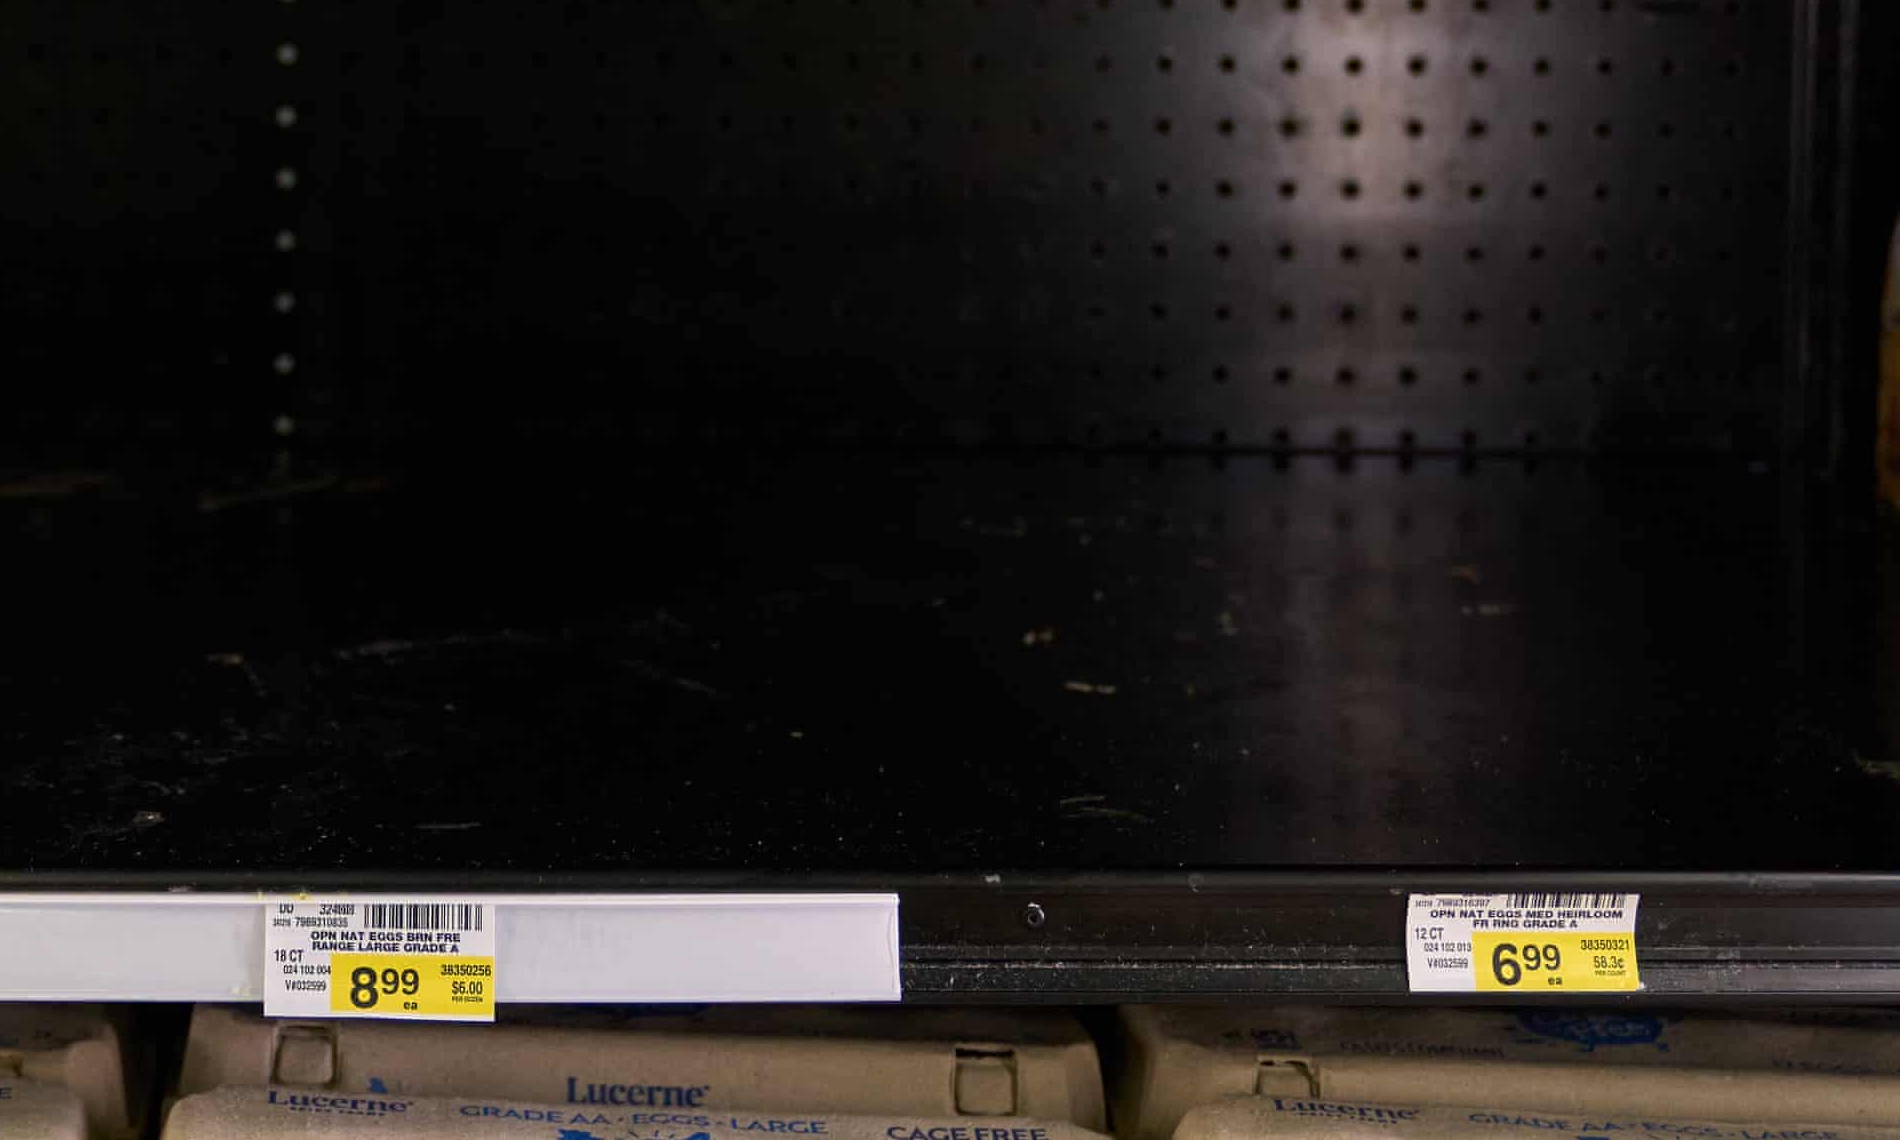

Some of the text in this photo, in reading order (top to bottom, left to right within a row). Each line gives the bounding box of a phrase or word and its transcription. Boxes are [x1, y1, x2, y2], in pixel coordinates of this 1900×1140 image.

[1430, 910, 1622, 919] OPN NAT EGGS MED HEIRLOOM
[1473, 920, 1489, 928] FR
[1523, 920, 1565, 928] GRADE
[1569, 920, 1578, 928] A
[311, 932, 460, 943] OPN NAT EGGS BRN FRE
[1415, 928, 1444, 940] 12 CT
[313, 943, 459, 953] RANGE LARGE GRADE A
[274, 950, 304, 961] 18 CT
[452, 981, 483, 995] $6.00
[567, 1076, 705, 1107] Lucerne
[268, 1090, 407, 1112] Lucerne
[458, 1104, 1046, 1140] GRADE AA EGGS LARGE CAGE FREE
